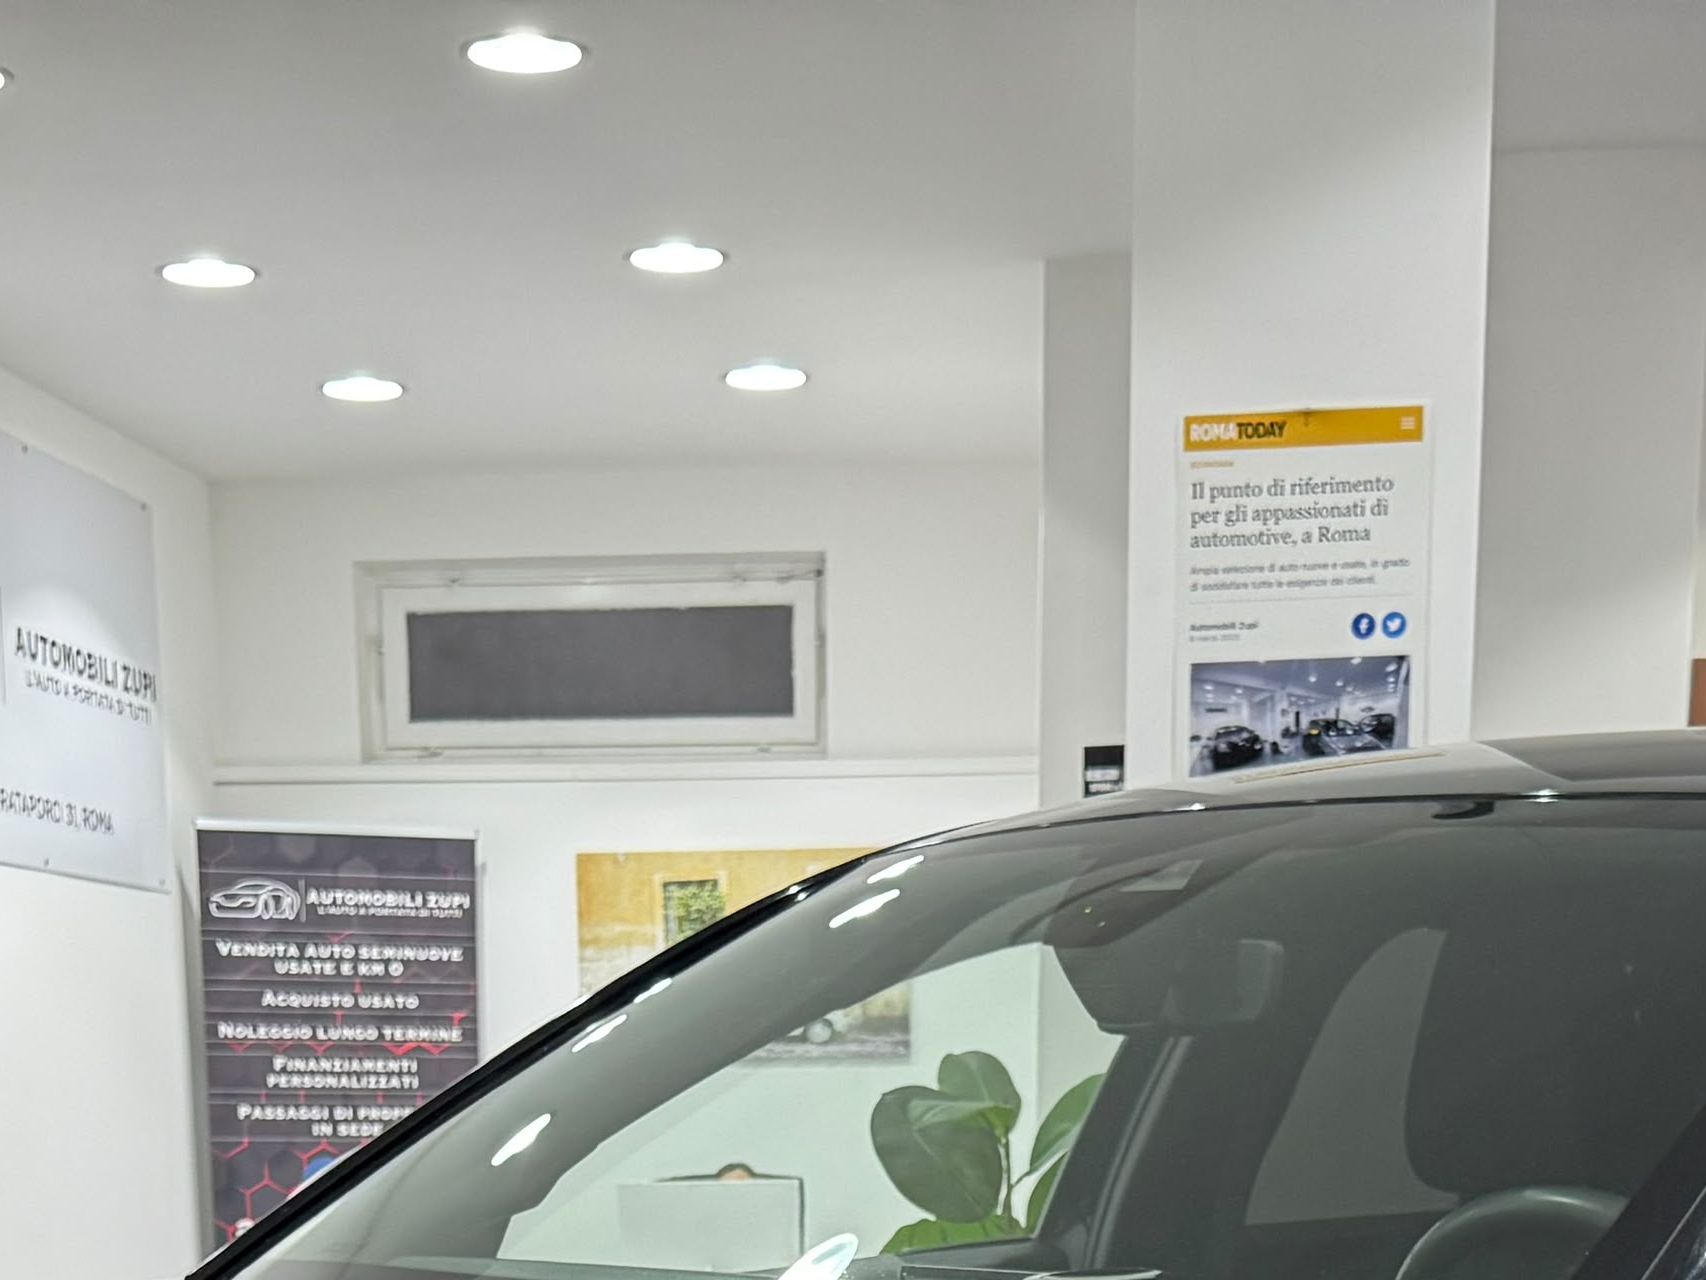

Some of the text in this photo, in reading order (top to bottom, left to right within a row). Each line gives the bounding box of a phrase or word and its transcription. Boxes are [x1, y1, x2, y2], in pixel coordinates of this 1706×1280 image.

[1190, 421, 1286, 441] ROMATODAY
[1191, 476, 1394, 503] Il punto di riferimento
[1190, 499, 1388, 529] per gli appassionati di
[1190, 526, 1371, 549] automotive, a Roma
[15, 626, 157, 702] AUTOMOBILI ZUPI
[82, 807, 115, 836] ROMA
[305, 888, 471, 910] AUTOMOBILI ZUPI
[304, 942, 355, 959] AUTO
[274, 960, 336, 976] USATE
[358, 994, 419, 1009] USATO
[266, 1074, 419, 1089] PERSONALIZZATI
